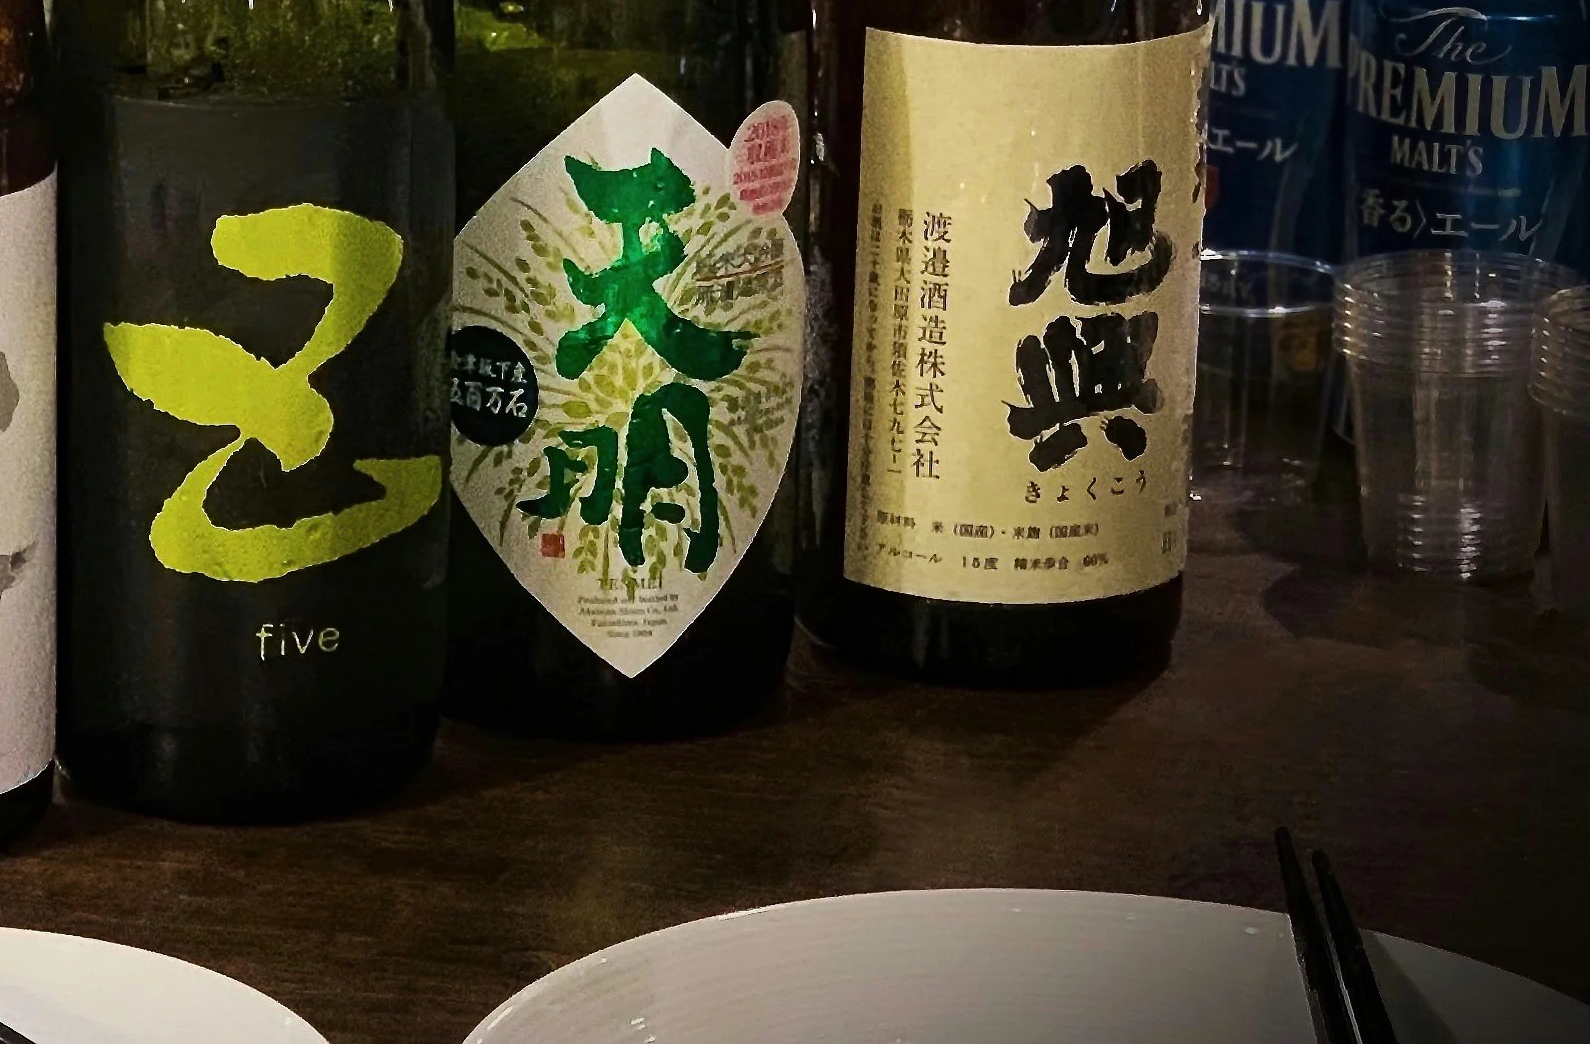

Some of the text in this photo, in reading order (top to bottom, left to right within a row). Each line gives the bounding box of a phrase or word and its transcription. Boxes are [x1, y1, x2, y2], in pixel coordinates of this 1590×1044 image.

[1379, 6, 1513, 66] The
[1347, 34, 1590, 141] PREMIUM
[1024, 469, 1147, 504] きょくこう
[255, 623, 341, 661] five
